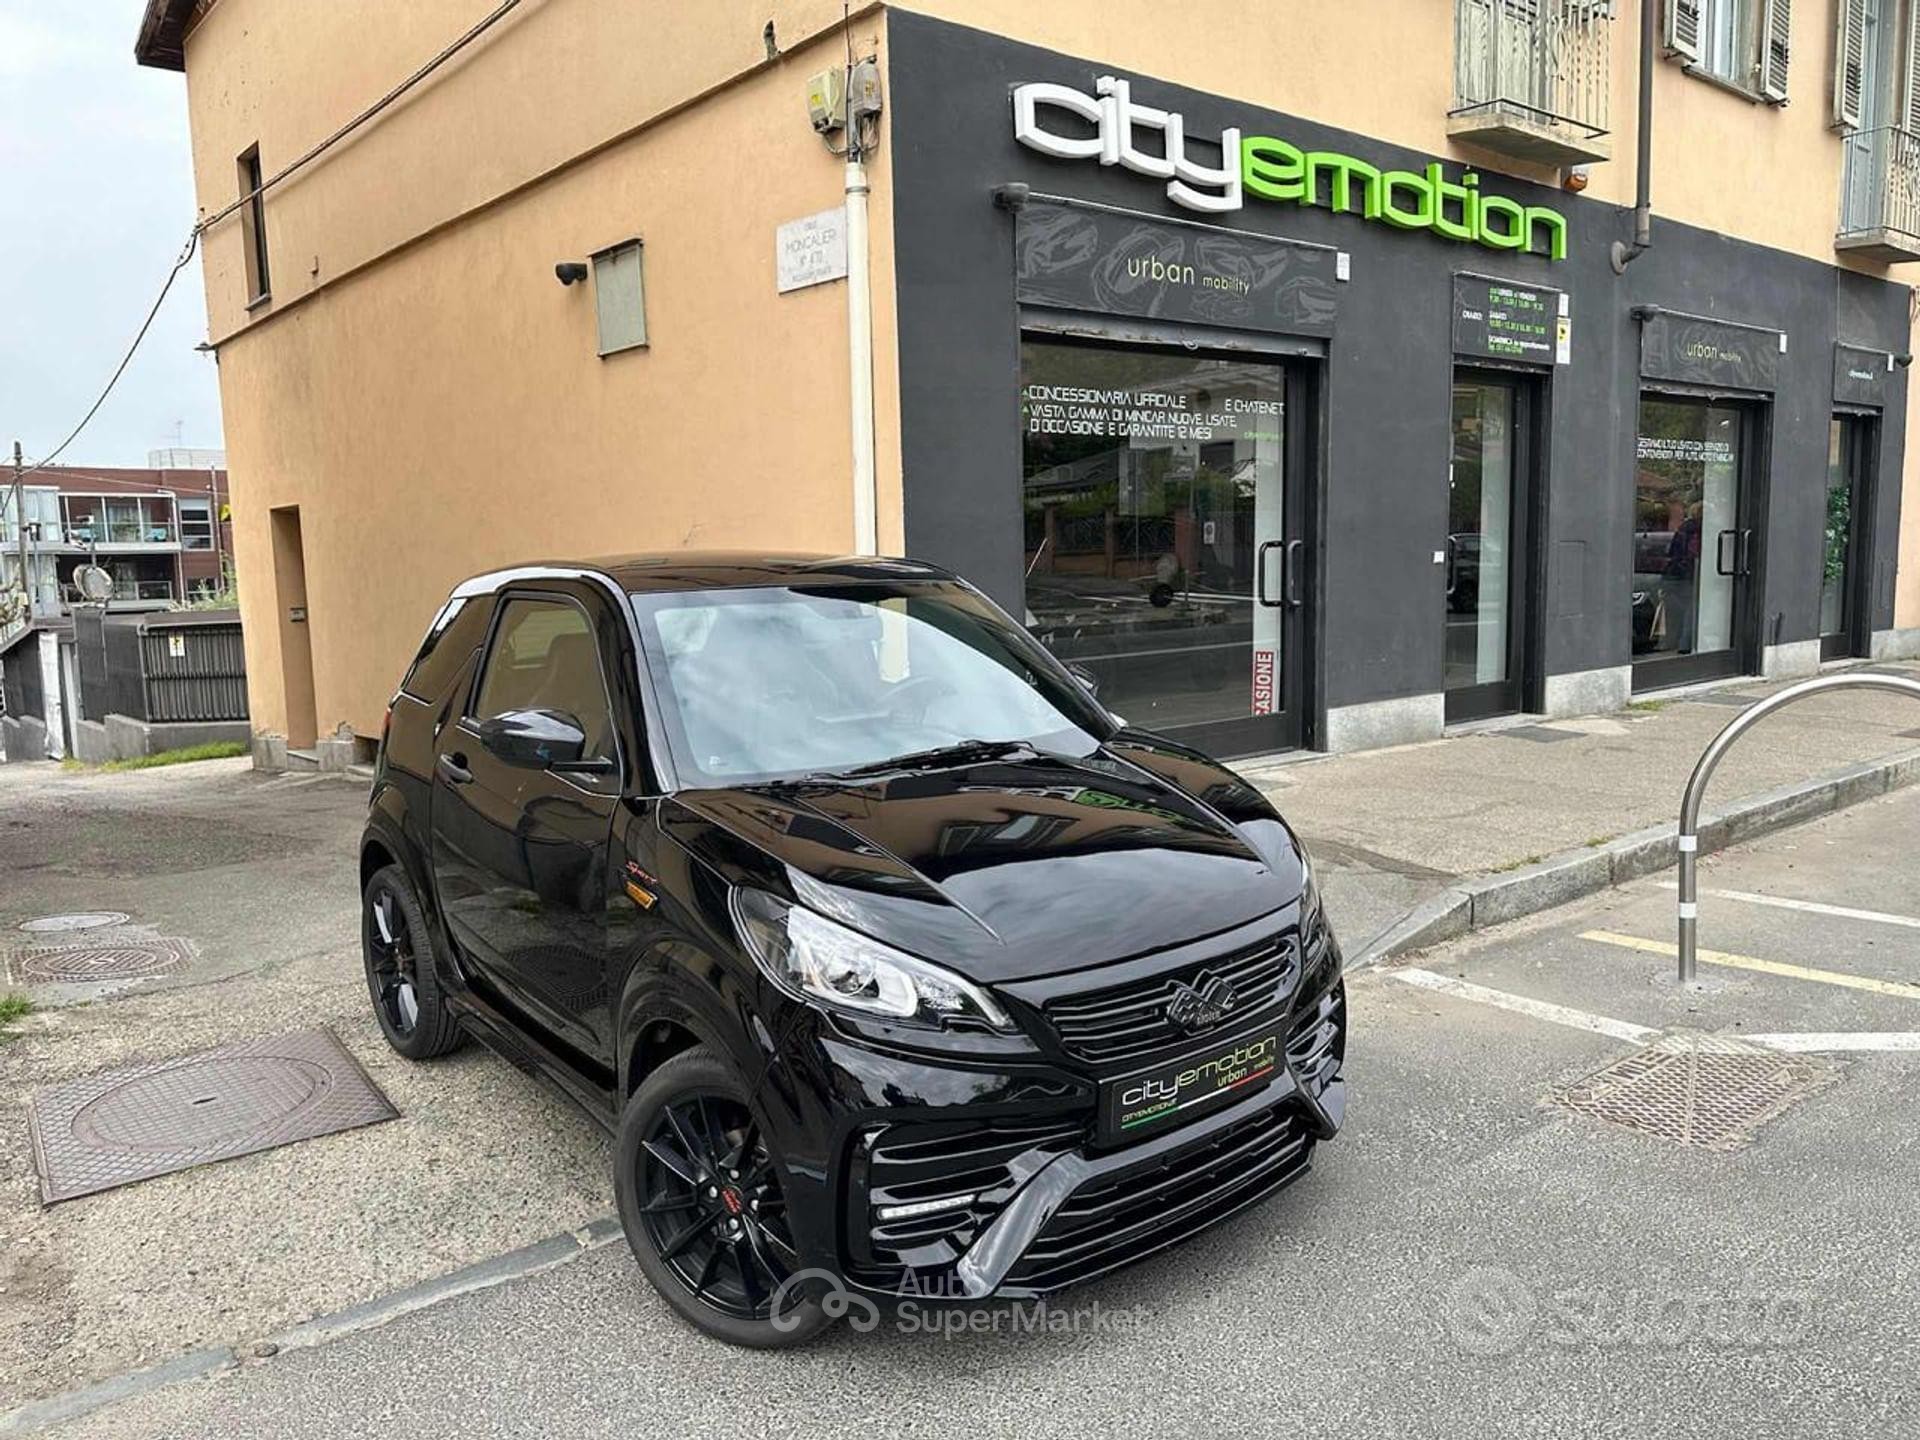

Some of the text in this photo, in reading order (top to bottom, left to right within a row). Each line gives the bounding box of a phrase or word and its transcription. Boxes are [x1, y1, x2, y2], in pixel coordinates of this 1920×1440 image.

[1128, 255, 1194, 285] urban
[1686, 341, 1717, 360] urban
[1029, 385, 1132, 406] CONCESSIONARIA
[1134, 391, 1187, 409] UFFICIALE
[1224, 398, 1232, 412] E
[1030, 403, 1066, 418] VASTA
[1068, 406, 1110, 421] GAMMA
[1108, 422, 1116, 437] E
[1119, 423, 1176, 439] GARANTITE
[1122, 1035, 1277, 1106] cityemotion
[1217, 1067, 1248, 1088] urban
